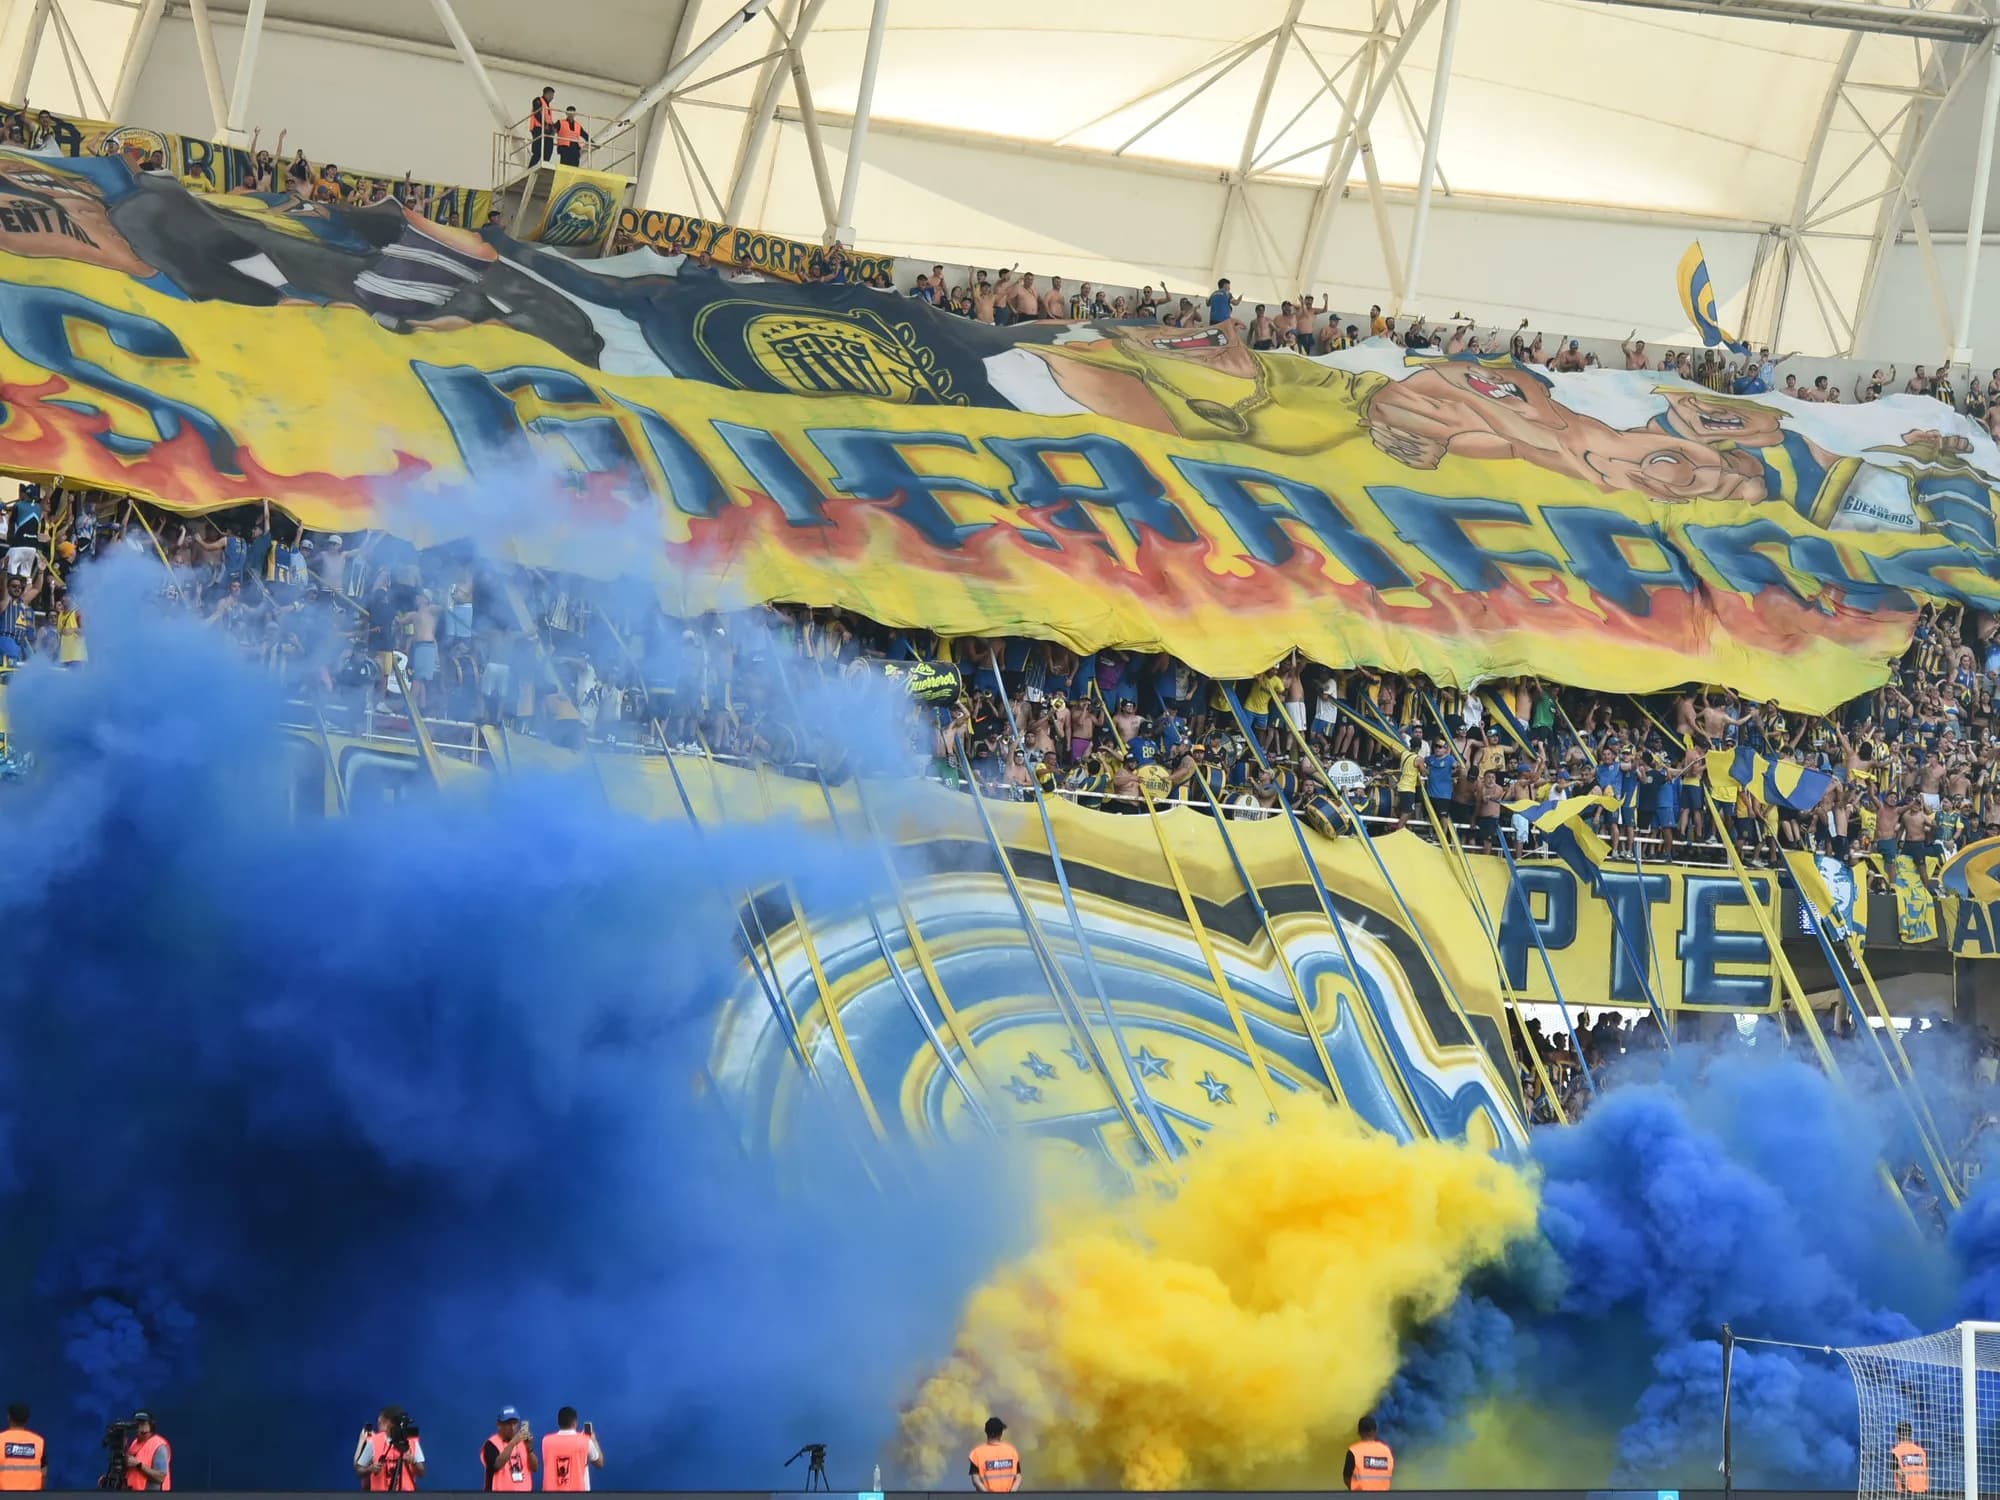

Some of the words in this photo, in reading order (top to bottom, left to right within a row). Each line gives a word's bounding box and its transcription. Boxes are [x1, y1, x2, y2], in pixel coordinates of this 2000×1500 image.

[706, 224, 731, 254] Y
[733, 229, 894, 285] BORRAHOS
[777, 336, 867, 360] CARC
[1844, 495, 1914, 525] GUERREROS
[1500, 865, 1773, 1007] PTE
